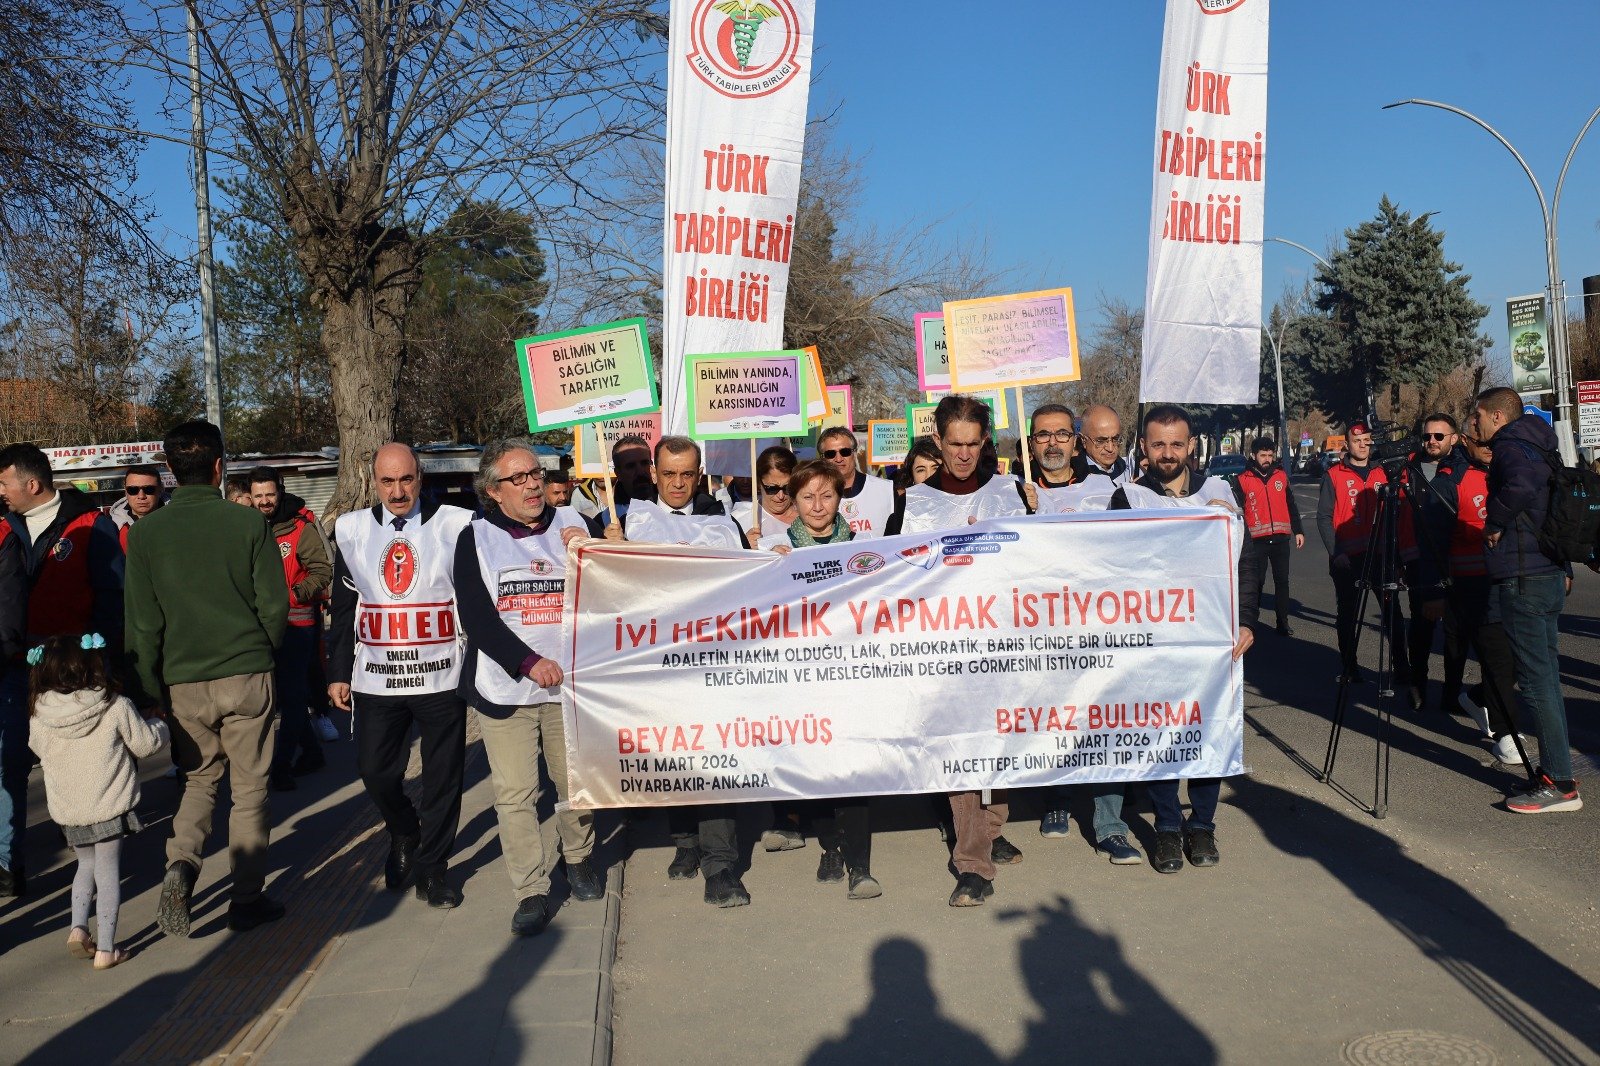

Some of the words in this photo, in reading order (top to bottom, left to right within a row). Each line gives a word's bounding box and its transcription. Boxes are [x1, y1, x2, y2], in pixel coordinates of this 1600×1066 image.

[695, 56, 715, 78] TÜRK
[715, 76, 760, 93] TABİPLERİ
[762, 63, 792, 88] BİRLİĞİ
[704, 143, 770, 195] TÜRK
[674, 206, 793, 263] TABİPLERİ
[686, 268, 769, 323] BİRLİĞİ
[1021, 306, 1058, 319] BİLİMSEL
[552, 342, 596, 362] BİLİMİN
[600, 340, 616, 353] VE
[559, 358, 616, 379] SAĞLIĞIN
[701, 367, 739, 380] BİLİMİN
[743, 367, 792, 379] YANINDA,
[560, 374, 621, 396] TARAFIYIZ
[715, 381, 779, 394] KARANLIĞIN
[709, 397, 786, 410] KARŞISINDAYIZ
[628, 420, 656, 430] HAYIR,
[53, 448, 97, 457] HAZAR
[99, 442, 162, 455] TÜTÜNCÜL
[849, 519, 872, 533] EYA
[516, 582, 531, 593] BİR
[532, 580, 562, 592] SAĞLIK
[512, 597, 527, 608] BİR
[359, 610, 454, 640] EVHED
[615, 616, 657, 651] İYİ
[672, 596, 832, 643] HEKİMLİK
[847, 594, 999, 635] YAPMAK
[1012, 586, 1195, 628] İSTİYORUZ!
[386, 647, 419, 661] EMEKLİ
[661, 648, 729, 668] ADALETİN
[734, 647, 779, 664] HAKİM
[784, 644, 847, 662] OLDUĞU,
[851, 641, 886, 660] LAİK,
[890, 637, 983, 657] DEMOKRATİK,
[987, 636, 1025, 653] BARIŞ
[1029, 634, 1074, 652] İÇİNDE
[1079, 632, 1100, 649] BİR
[1104, 632, 1154, 648] ÜLKEDE
[364, 661, 405, 675] VETERİNER
[406, 657, 452, 675] HEKİMLER
[705, 668, 788, 687] EMEĞİMİZİN
[793, 667, 811, 683] VE
[816, 661, 914, 682] MESLEĞİMİZİN
[918, 659, 963, 676] DEĞER
[968, 655, 1042, 674] GÖRMESİNİ
[1046, 653, 1114, 671] İSTİYORUZ
[385, 674, 425, 688] DERNEĞİ
[996, 705, 1078, 734] BEYAZ
[1088, 701, 1202, 730] BULUŞMA
[618, 724, 705, 755] BEYAZ
[715, 713, 833, 749] YÜRÜYÜŞ
[1055, 736, 1068, 750] 14
[1073, 733, 1109, 750] MART
[1115, 732, 1151, 747] 2026
[1156, 731, 1163, 746] /
[1168, 729, 1202, 745] 13.00
[619, 758, 649, 773] 11-14
[654, 756, 696, 772] MART
[701, 754, 739, 770] 2026
[943, 756, 1020, 774] HACETTEPE
[1024, 749, 1108, 769] ÜNİVERSİTESİ
[1113, 750, 1133, 766] TIP
[1138, 745, 1203, 764] FAKÜLTESİ
[620, 772, 770, 793] DİYARBAKIR-ANKARA
